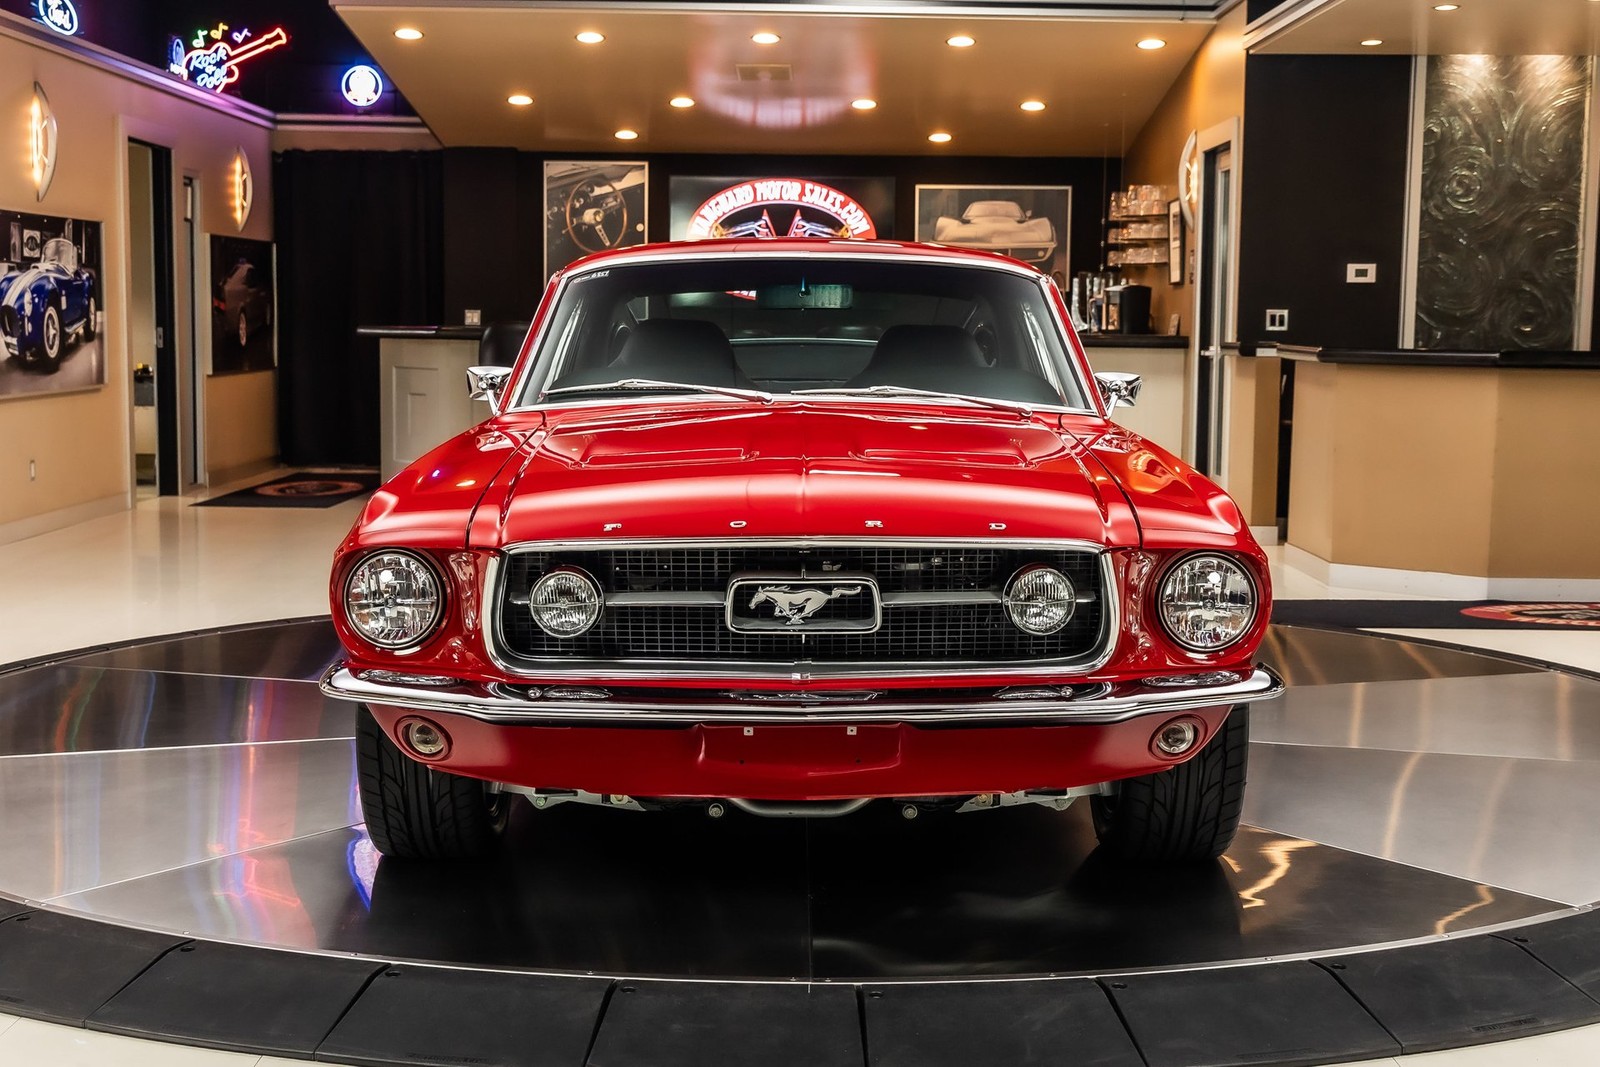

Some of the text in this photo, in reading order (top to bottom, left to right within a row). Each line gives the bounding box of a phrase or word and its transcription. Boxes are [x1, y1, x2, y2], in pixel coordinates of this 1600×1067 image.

[189, 45, 228, 71] Rock
[691, 180, 870, 237] VANGUARD MOTOR SALES.COM
